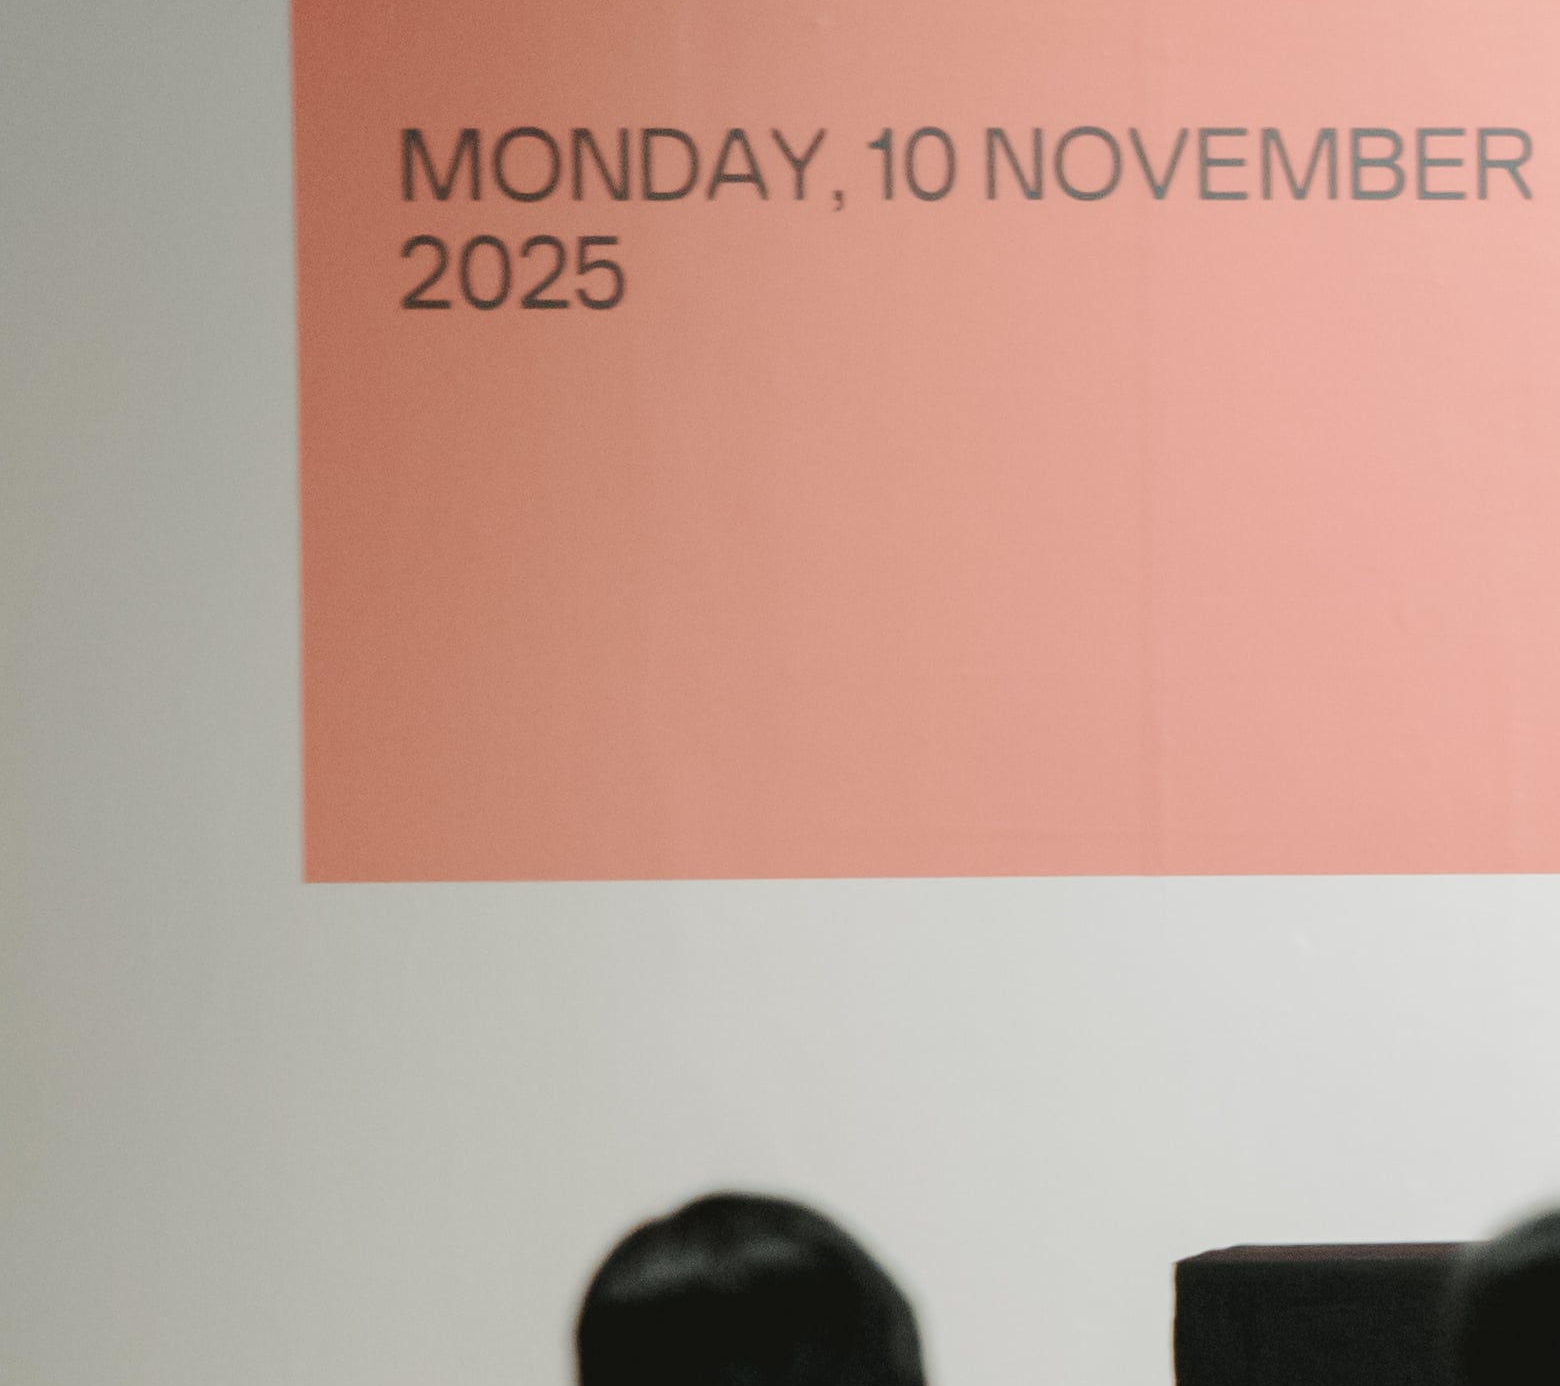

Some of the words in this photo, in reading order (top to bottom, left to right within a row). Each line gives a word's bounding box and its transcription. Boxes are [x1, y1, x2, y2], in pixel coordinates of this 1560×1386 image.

[403, 126, 846, 211] MONDAY,
[868, 126, 956, 202] 10
[985, 125, 1534, 202] NOVEMBER
[402, 234, 625, 311] 2025
